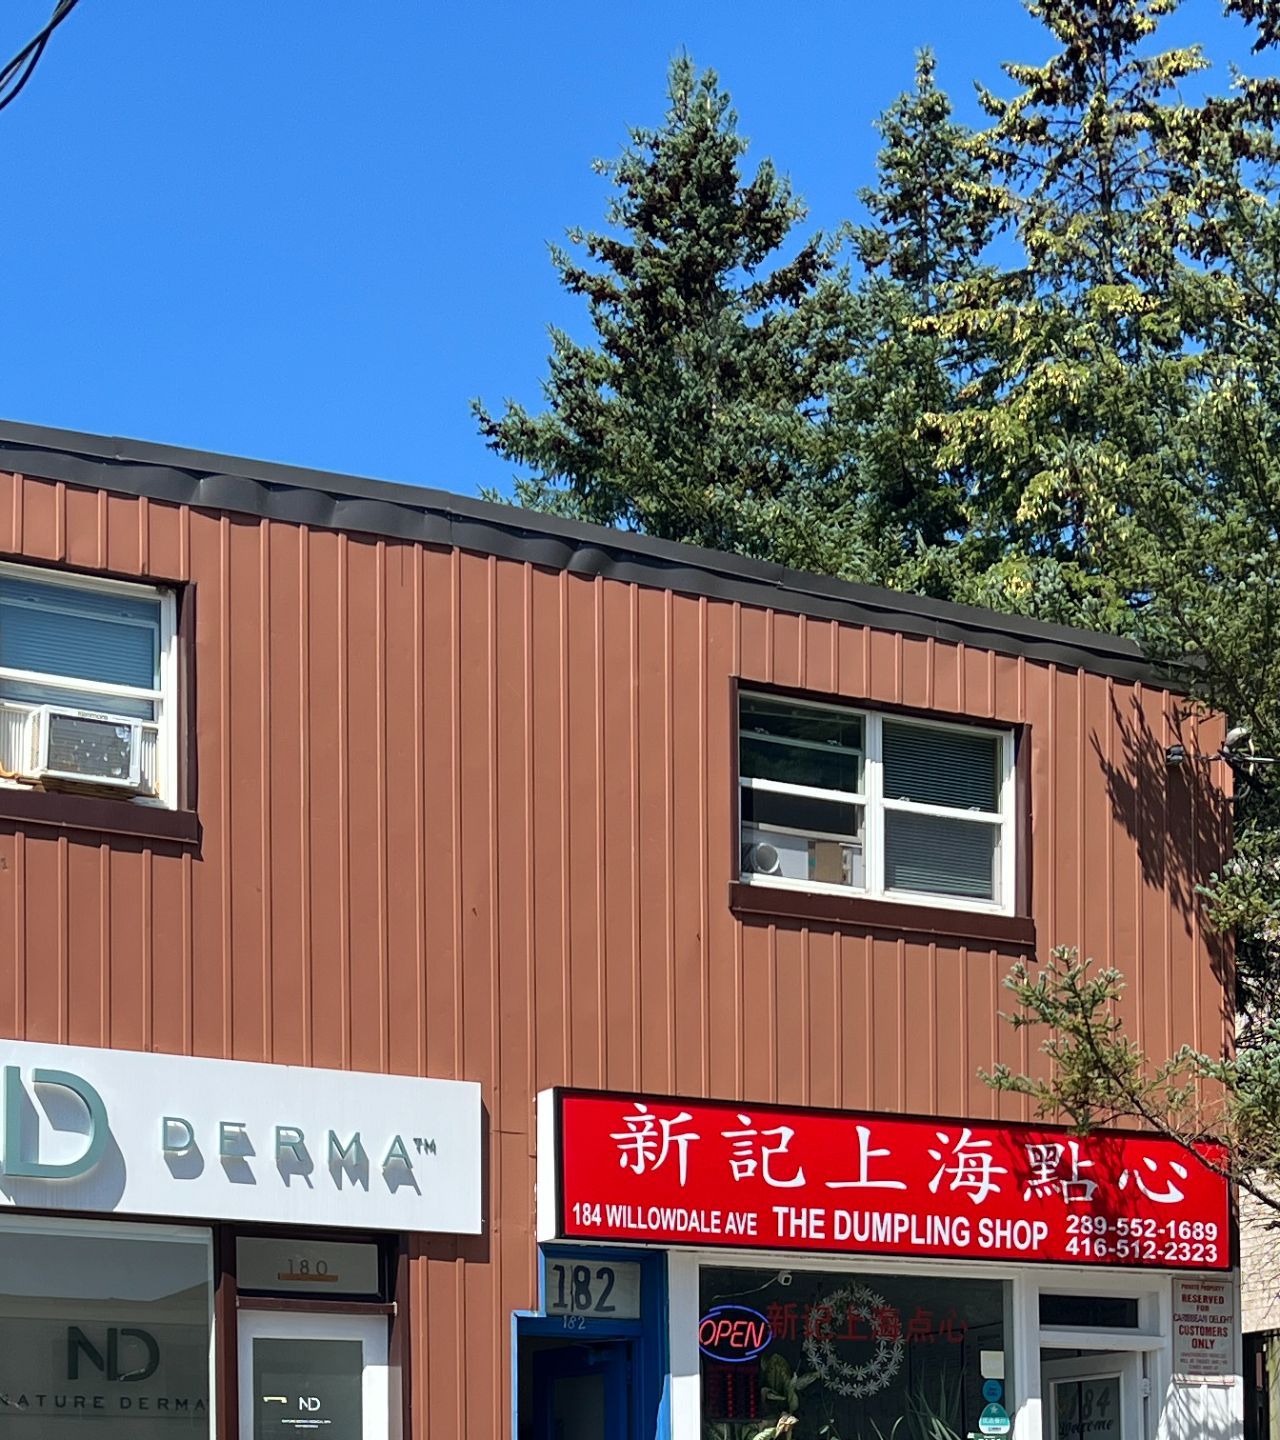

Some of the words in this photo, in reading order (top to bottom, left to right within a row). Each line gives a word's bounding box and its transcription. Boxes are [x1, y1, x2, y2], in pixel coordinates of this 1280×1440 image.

[609, 1102, 1189, 1206] 新記上海點心
[572, 1202, 602, 1227] 184
[606, 1204, 721, 1233] WILLOWDALE
[725, 1212, 758, 1235] AVE
[772, 1206, 826, 1239] THE
[833, 1209, 970, 1247] DUMPLING
[977, 1217, 1049, 1250] SHOP
[1065, 1214, 1218, 1241] 289-552-1689
[1065, 1236, 1218, 1262] 416-512-2323
[288, 1259, 328, 1275] 180
[552, 1264, 616, 1312] 182
[1181, 1294, 1225, 1305] RESERVED
[1196, 1304, 1210, 1312] FOR
[563, 1315, 587, 1330] 182
[698, 1319, 765, 1349] OPEN
[1178, 1324, 1229, 1338] CUSTOMERS
[1191, 1338, 1216, 1350] ONLY
[67, 1326, 161, 1382] ND
[120, 1396, 206, 1411] DERMA
[298, 1396, 321, 1411] ND
